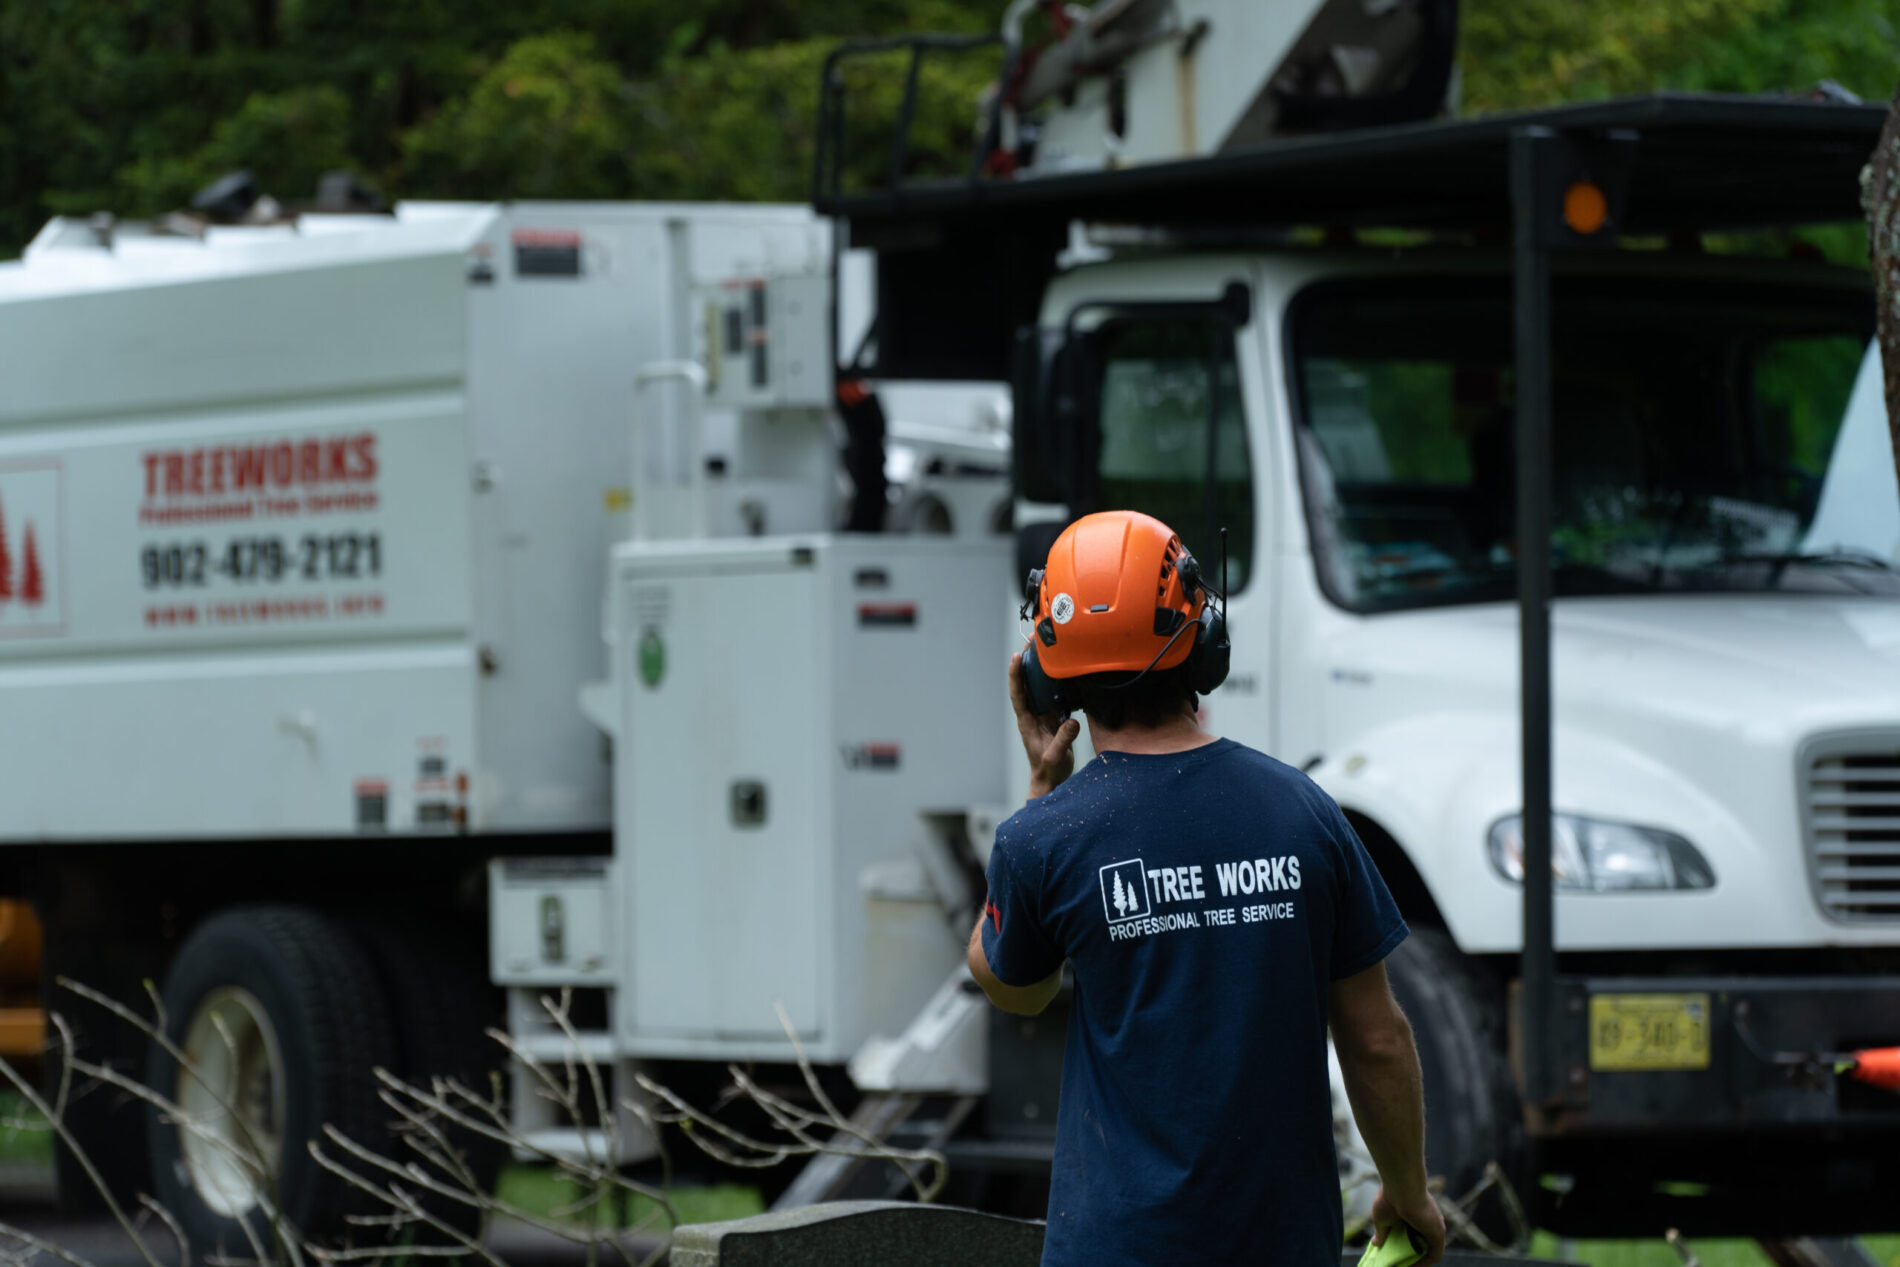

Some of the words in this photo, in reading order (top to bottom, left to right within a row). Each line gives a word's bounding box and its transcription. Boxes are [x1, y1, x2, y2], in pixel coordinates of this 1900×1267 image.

[142, 434, 378, 497] TREEWORKS
[142, 533, 380, 587] 902-479-2121
[1147, 866, 1206, 904] TREE
[1215, 855, 1302, 897] WORKS
[1108, 911, 1201, 942] PROFESSIONAL
[1203, 908, 1236, 927] TREE
[1241, 902, 1295, 924] SERVICE
